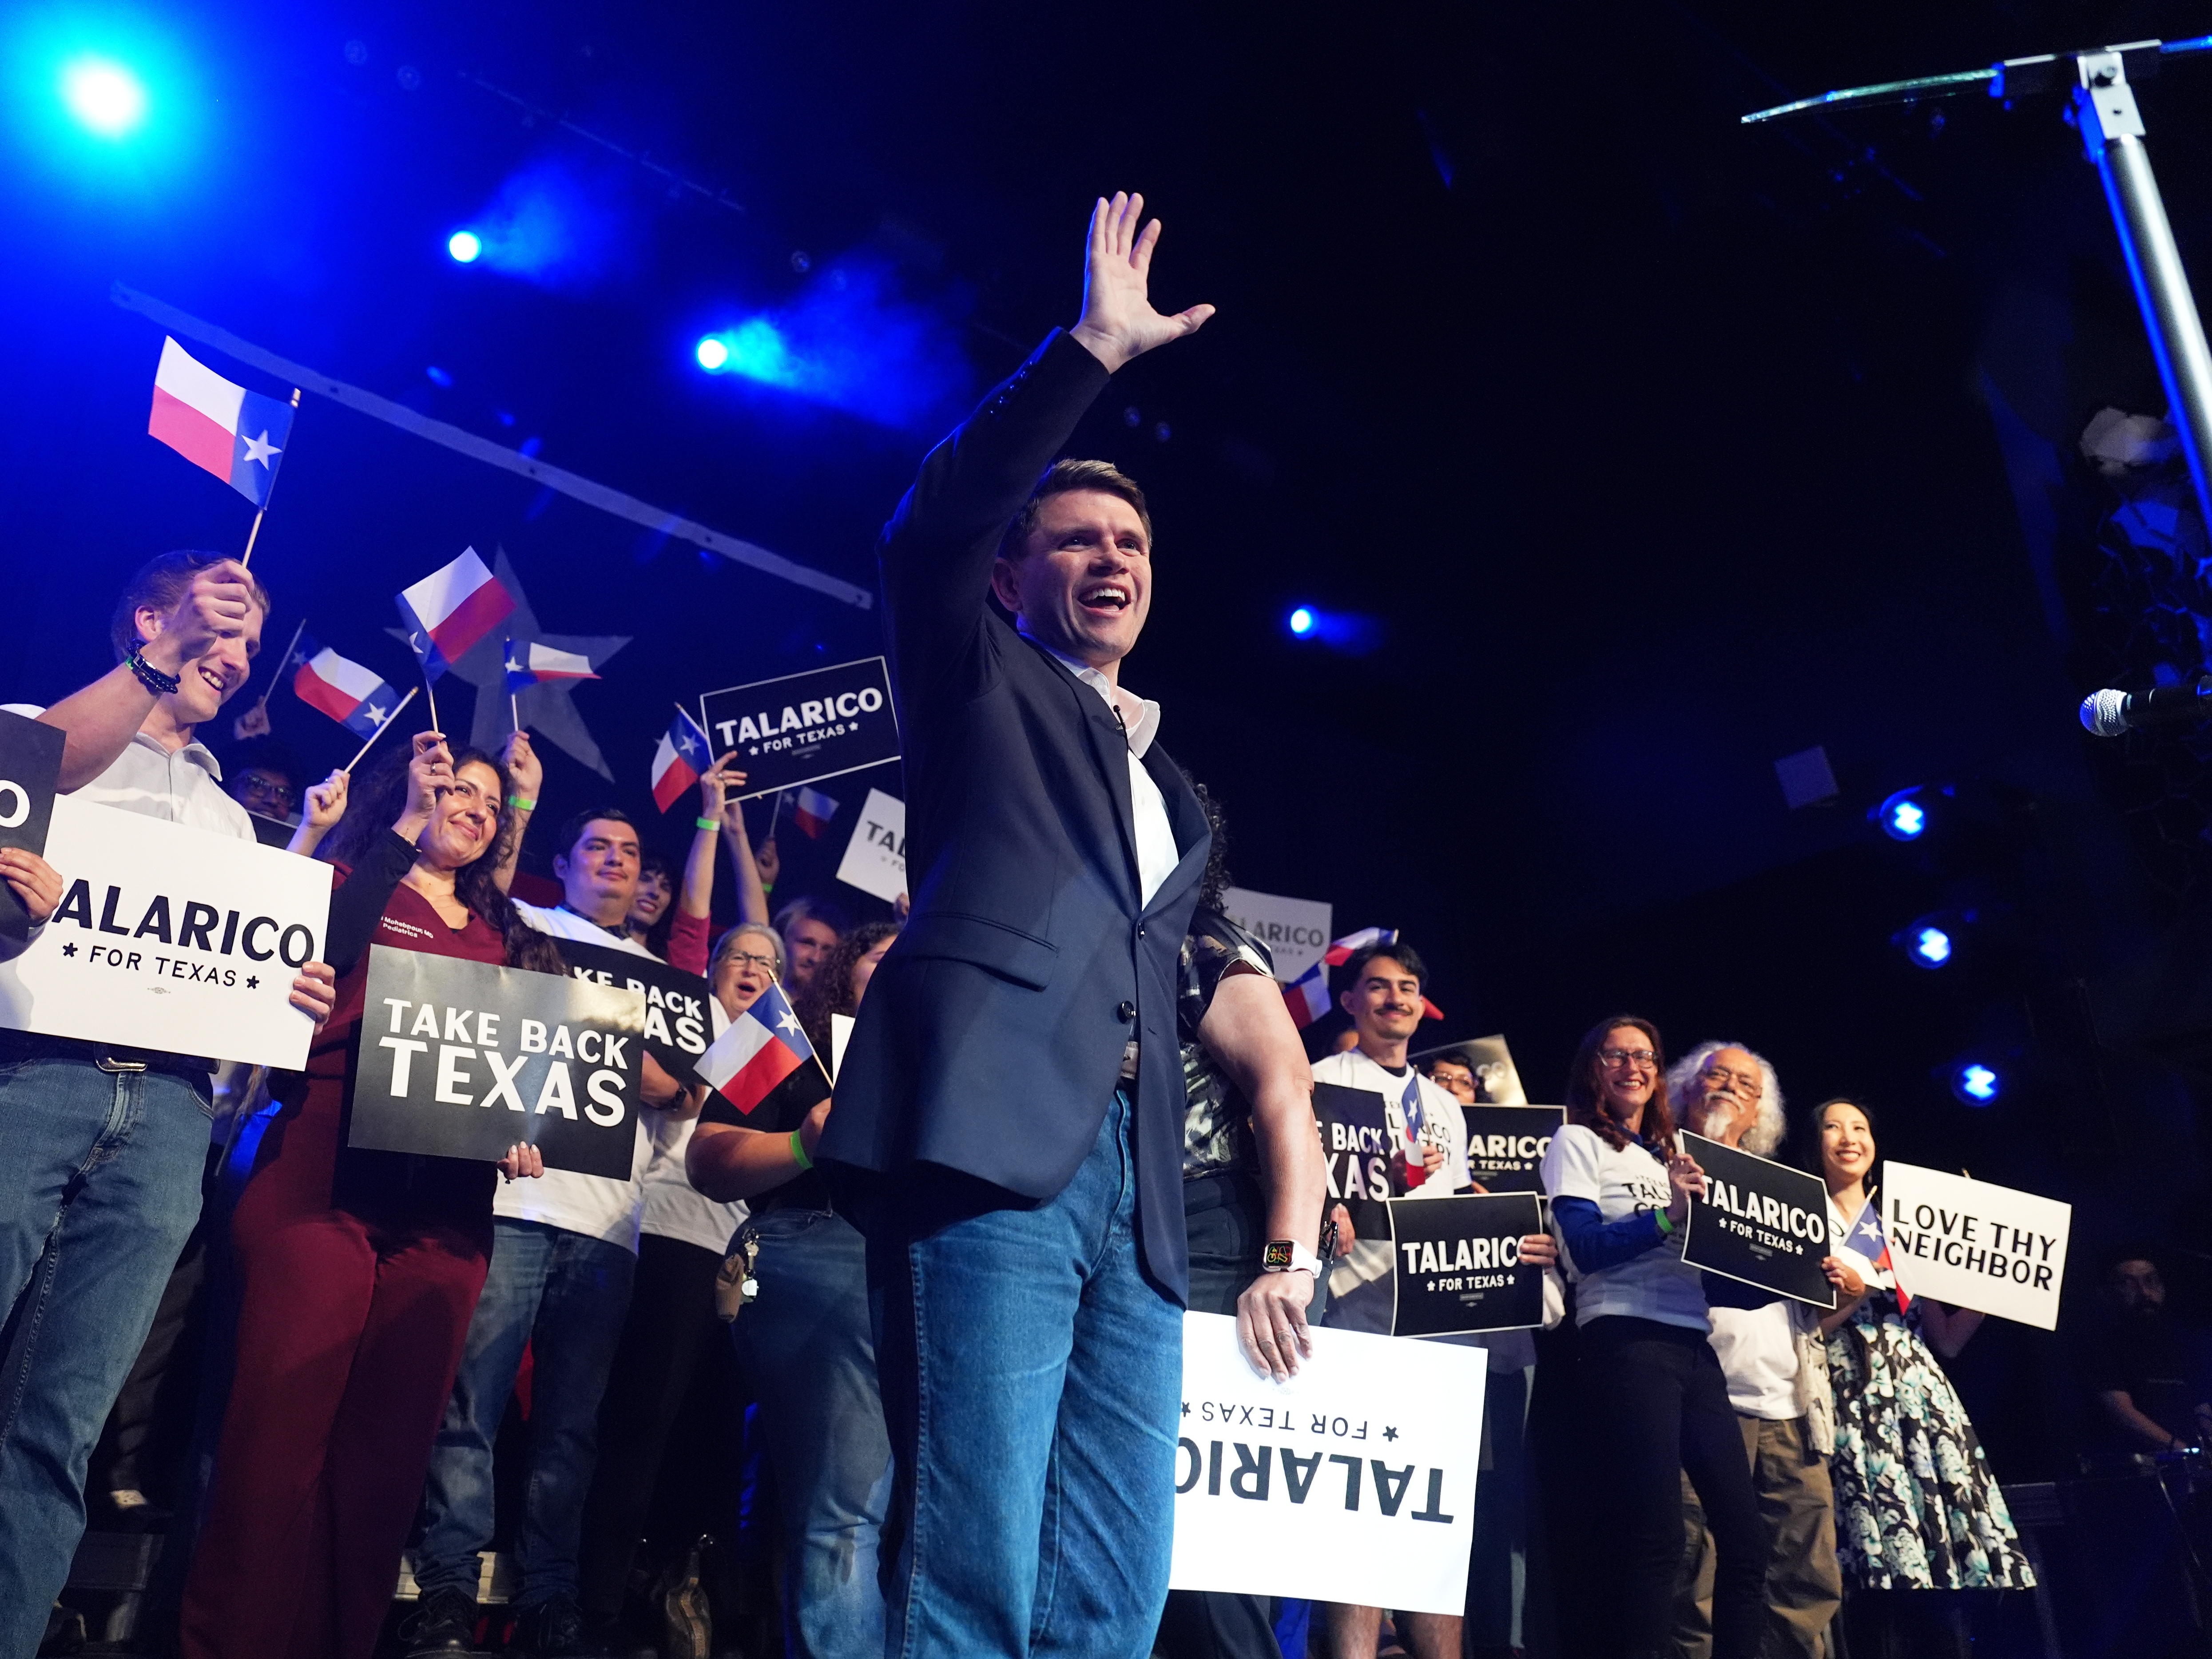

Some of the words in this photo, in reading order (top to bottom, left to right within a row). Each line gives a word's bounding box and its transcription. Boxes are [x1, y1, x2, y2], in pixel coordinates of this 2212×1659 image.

[715, 687, 883, 746] TALARICO
[762, 737, 792, 754] FOR
[796, 724, 845, 744] TEXAS
[52, 879, 314, 968] ALARICO
[383, 922, 418, 938] Pediatrics
[424, 929, 433, 938] MD
[1240, 917, 1324, 947] ARICO
[89, 945, 141, 971] FOR
[155, 957, 236, 987] TEXAS
[574, 966, 613, 986] KE
[627, 978, 703, 1021] BACK
[383, 998, 500, 1047] TAKE
[520, 1019, 628, 1069] BACK
[379, 1036, 627, 1127] TEXAS
[1331, 1123, 1385, 1155] BACK
[1467, 1134, 1553, 1159] ARIC
[1323, 1152, 1390, 1202] XAS
[1479, 1160, 1521, 1171] TEXAS
[1702, 1175, 1825, 1244] TALARICO
[1730, 1220, 1753, 1239] FOR
[1756, 1229, 1793, 1253] TEXAS
[1893, 1199, 1978, 1242] LOVE
[1990, 1222, 2057, 1261] THY
[1893, 1227, 2053, 1291] NEIGHBOR
[1439, 1278, 1462, 1292] FOR
[1466, 1274, 1505, 1289] TEXAS
[1202, 1401, 1295, 1430] TEXAS
[1311, 1414, 1367, 1440] FOR
[1175, 1437, 1454, 1524] TALARIC
